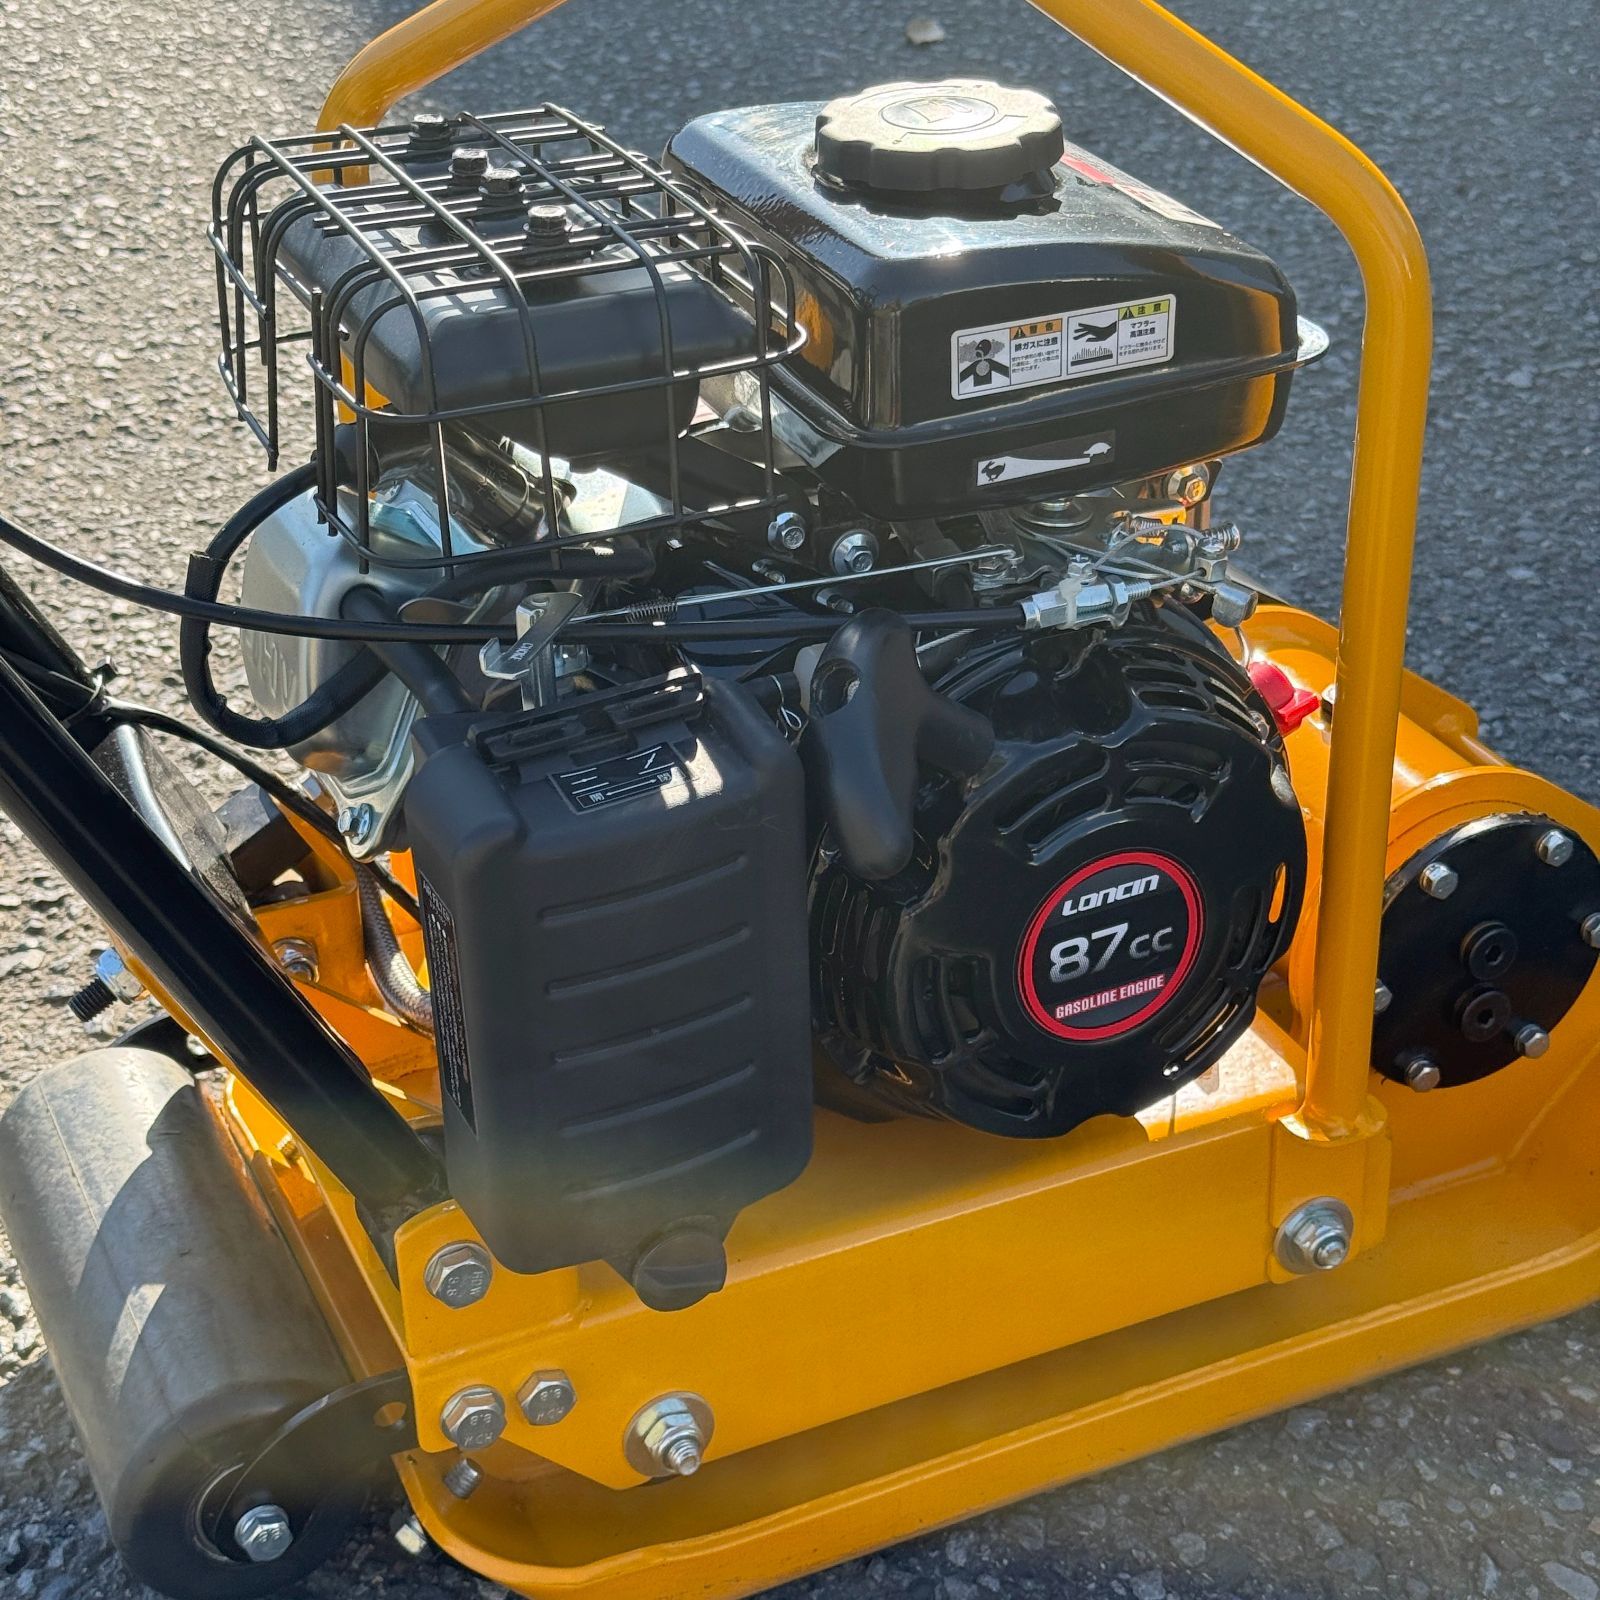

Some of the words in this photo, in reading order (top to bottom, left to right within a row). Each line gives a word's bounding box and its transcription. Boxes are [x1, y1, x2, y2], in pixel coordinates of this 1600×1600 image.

[1130, 320, 1156, 329] マフラー
[1061, 874, 1160, 916] LONCIN
[1055, 990, 1117, 1020] GASOLINE
[1119, 974, 1166, 1000] ENGINE
